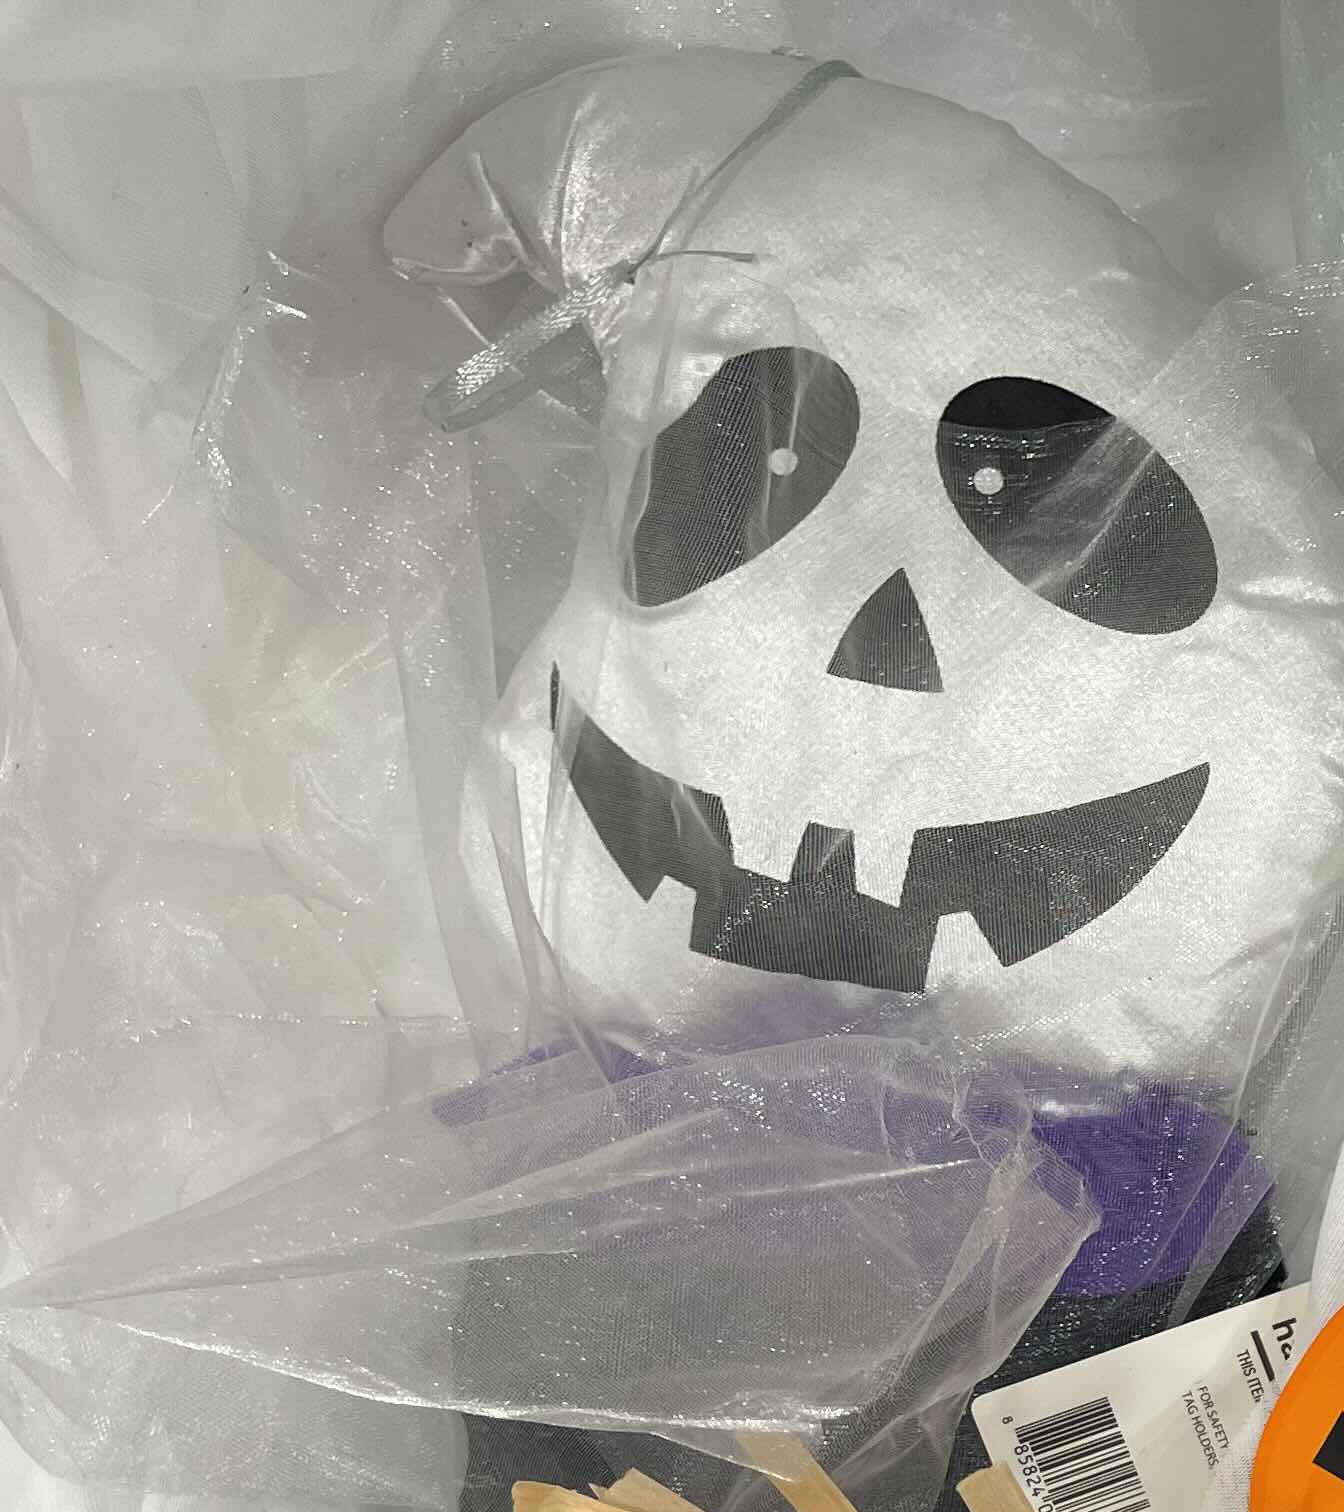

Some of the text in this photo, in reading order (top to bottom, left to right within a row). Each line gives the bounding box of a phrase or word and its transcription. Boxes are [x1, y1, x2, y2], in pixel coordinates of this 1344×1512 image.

[1236, 1349, 1256, 1377] THIS
[1181, 1391, 1198, 1415] TAG
[1197, 1385, 1230, 1449] FOR SAFETY
[1002, 1415, 1014, 1425] 8
[1014, 1444, 1046, 1497] 85824
